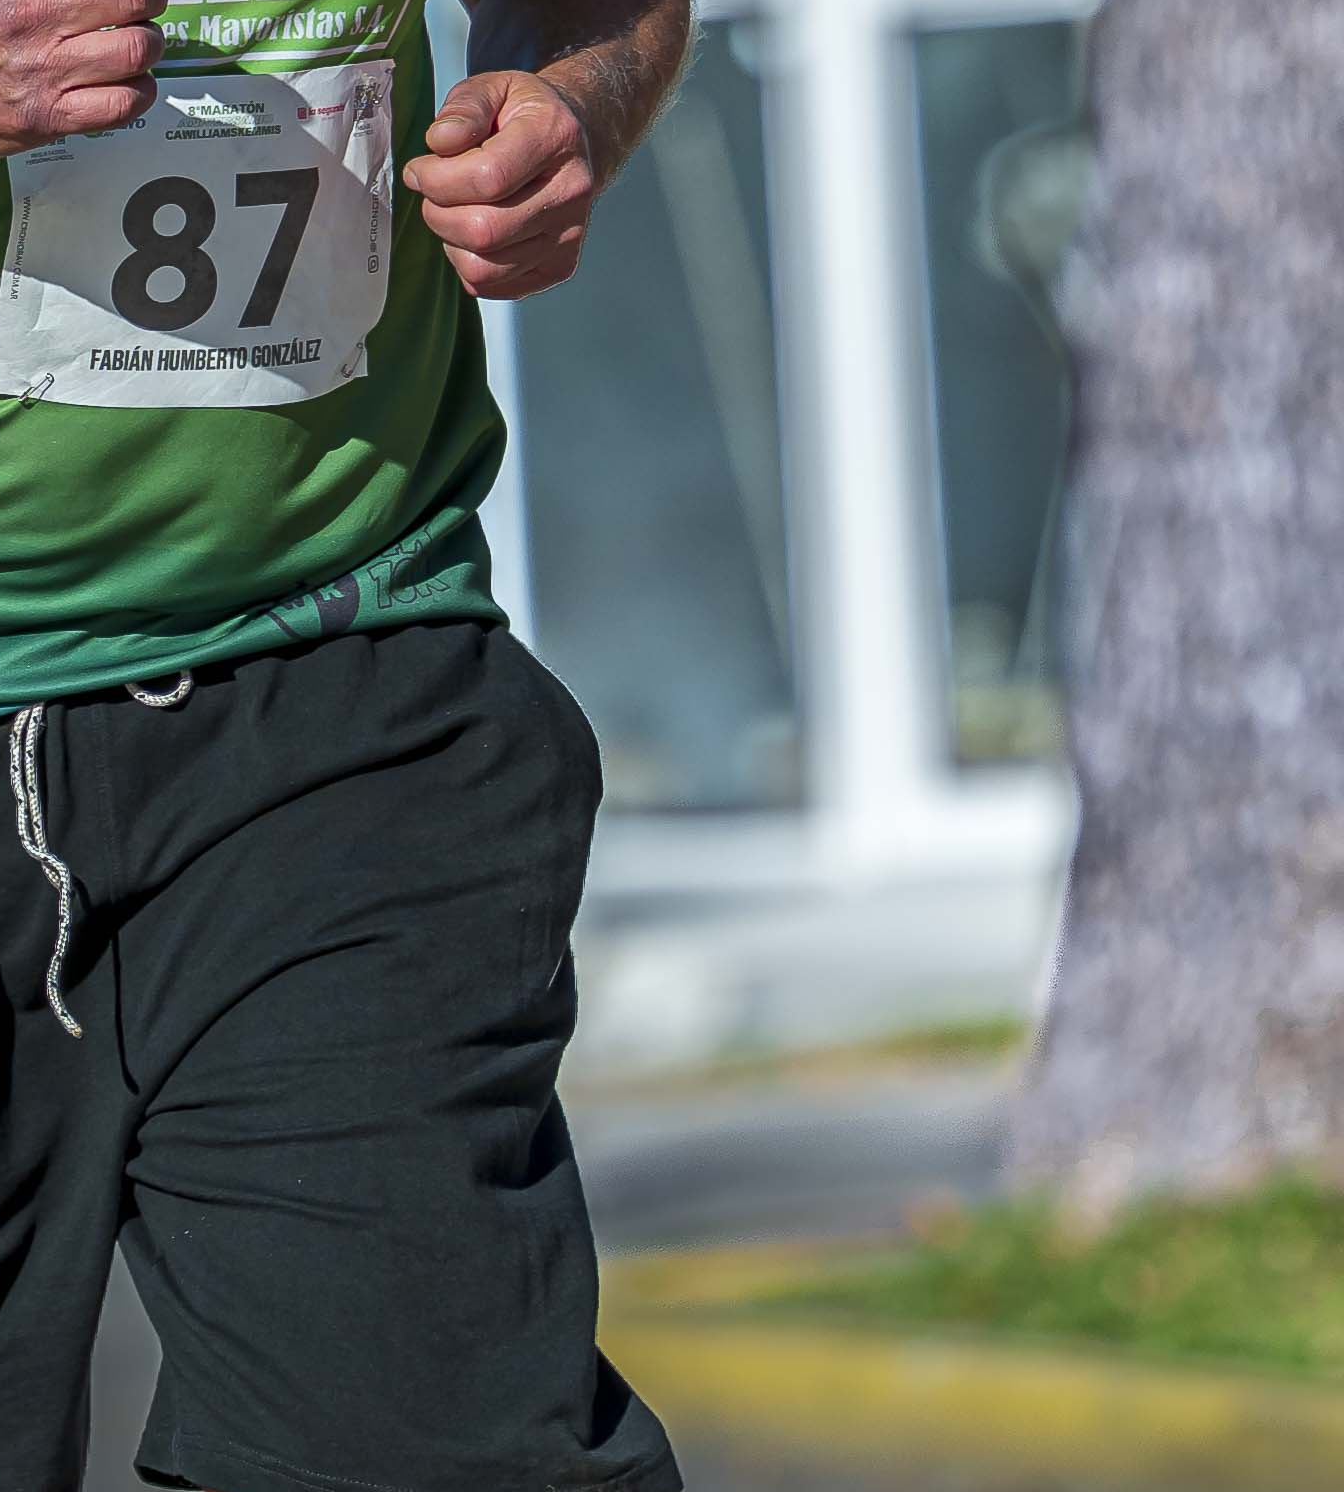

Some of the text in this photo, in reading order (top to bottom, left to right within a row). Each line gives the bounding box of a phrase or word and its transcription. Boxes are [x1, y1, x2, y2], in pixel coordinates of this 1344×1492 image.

[199, 5, 346, 49] Mayoristas
[111, 166, 320, 332] 87
[89, 337, 323, 372] FABIÁN HUMBERTO GONZÁLEZ
